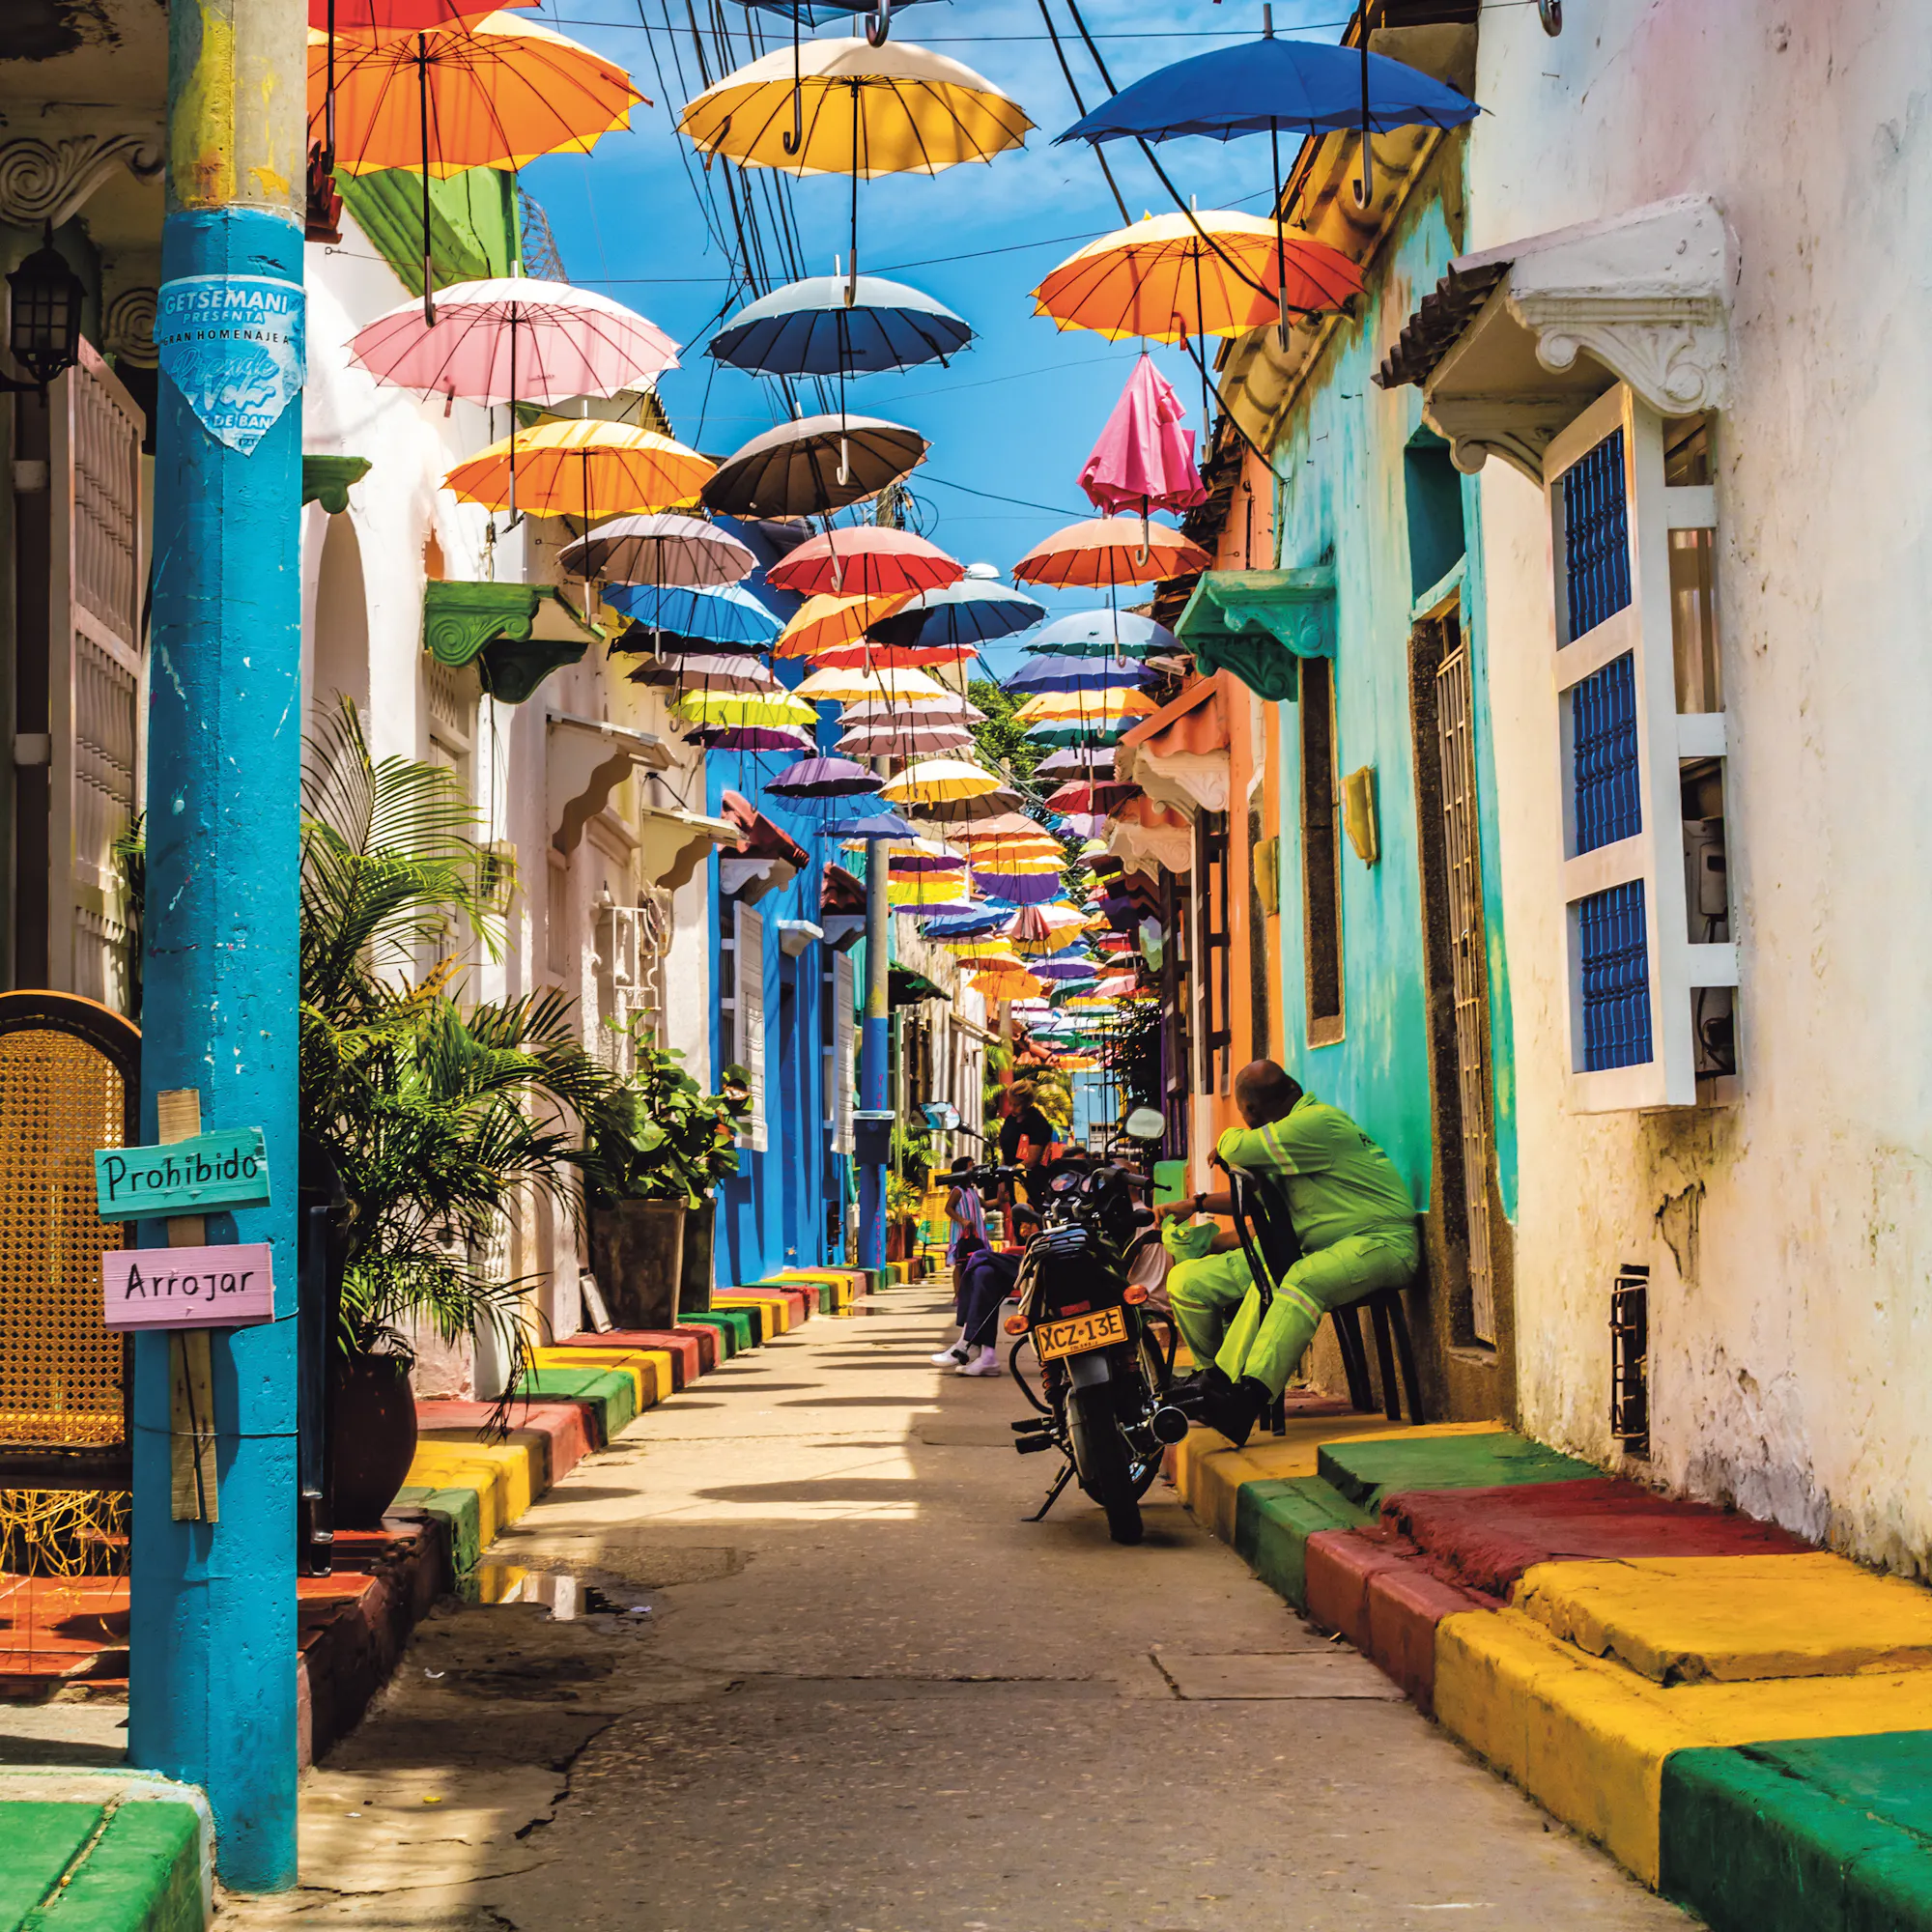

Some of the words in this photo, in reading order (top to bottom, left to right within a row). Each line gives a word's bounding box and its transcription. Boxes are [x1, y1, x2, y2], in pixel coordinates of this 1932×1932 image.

[165, 290, 288, 315] GETSEMANI
[183, 310, 264, 324] PRESENTA
[163, 332, 192, 346] GRAN
[197, 329, 278, 343] HOMENAJE
[283, 335, 290, 345] A
[214, 415, 234, 426] DE
[102, 1148, 258, 1202] Prohibido
[126, 1264, 254, 1301] Arrojar
